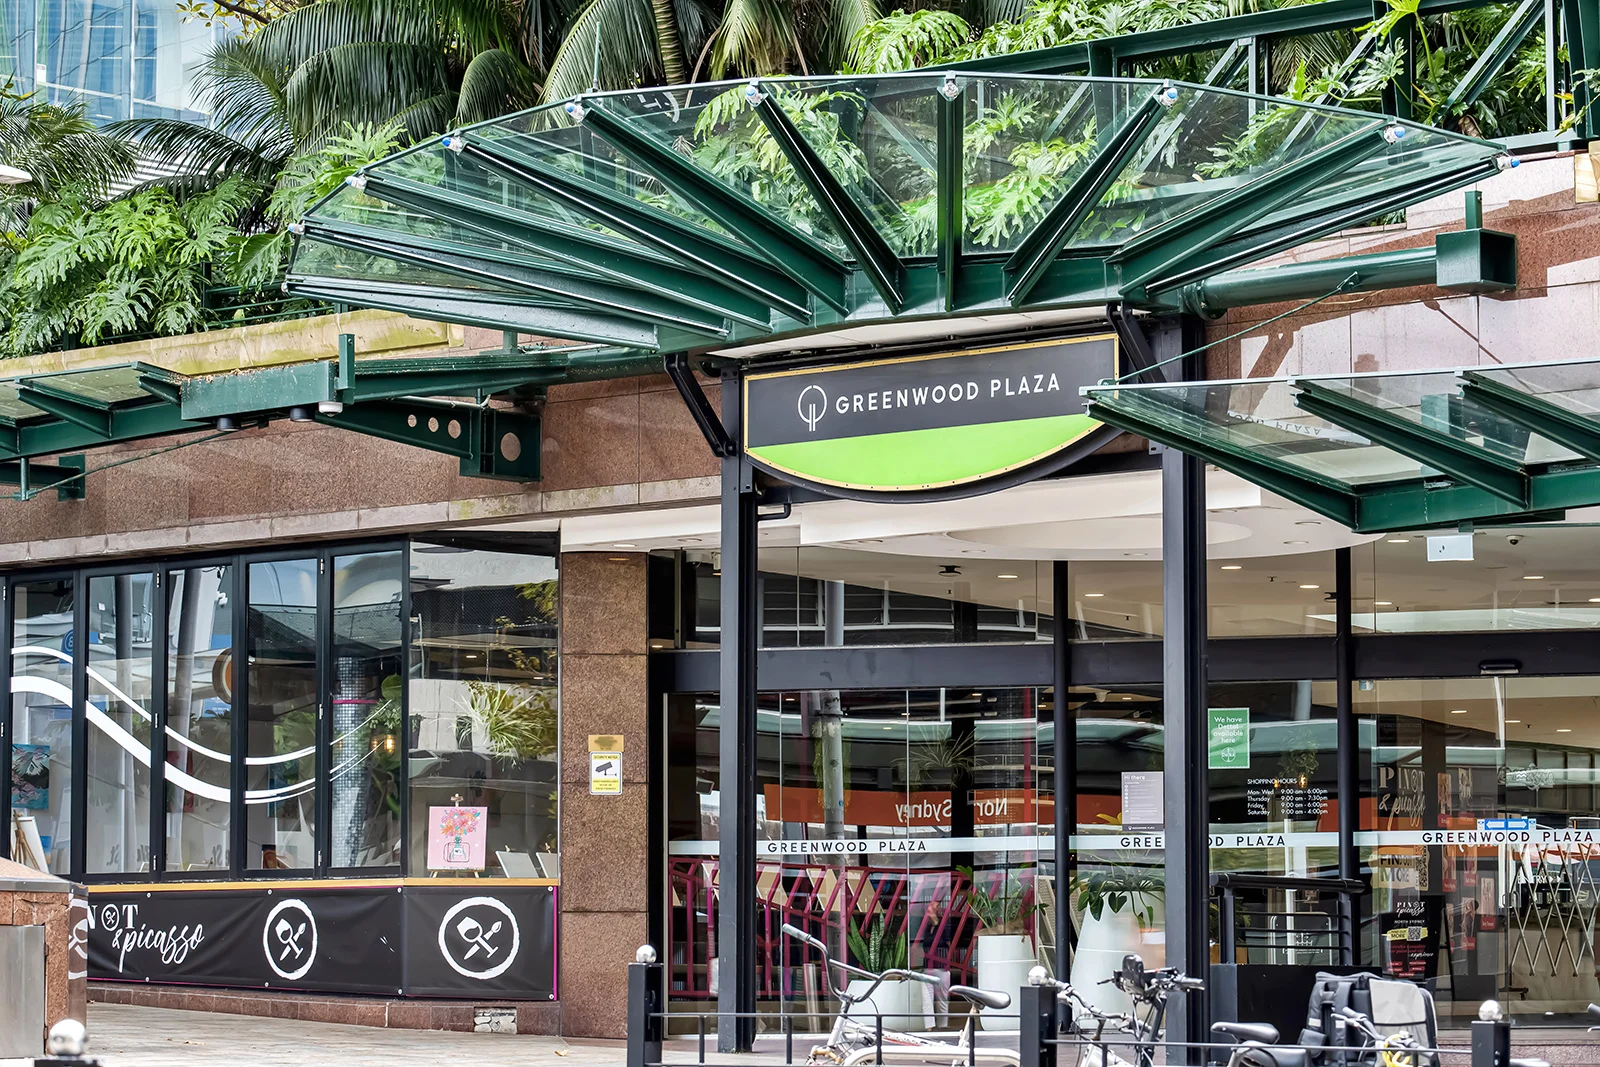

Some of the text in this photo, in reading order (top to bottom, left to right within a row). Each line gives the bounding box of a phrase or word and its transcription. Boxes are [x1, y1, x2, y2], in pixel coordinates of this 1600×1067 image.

[835, 372, 1060, 414] GREENWOOD PLAZA
[1120, 836, 1285, 848] GREED PLAZA
[1422, 831, 1594, 843] GREENWOOD PLAZA
[767, 840, 927, 853] GREENWOOD PLAZA
